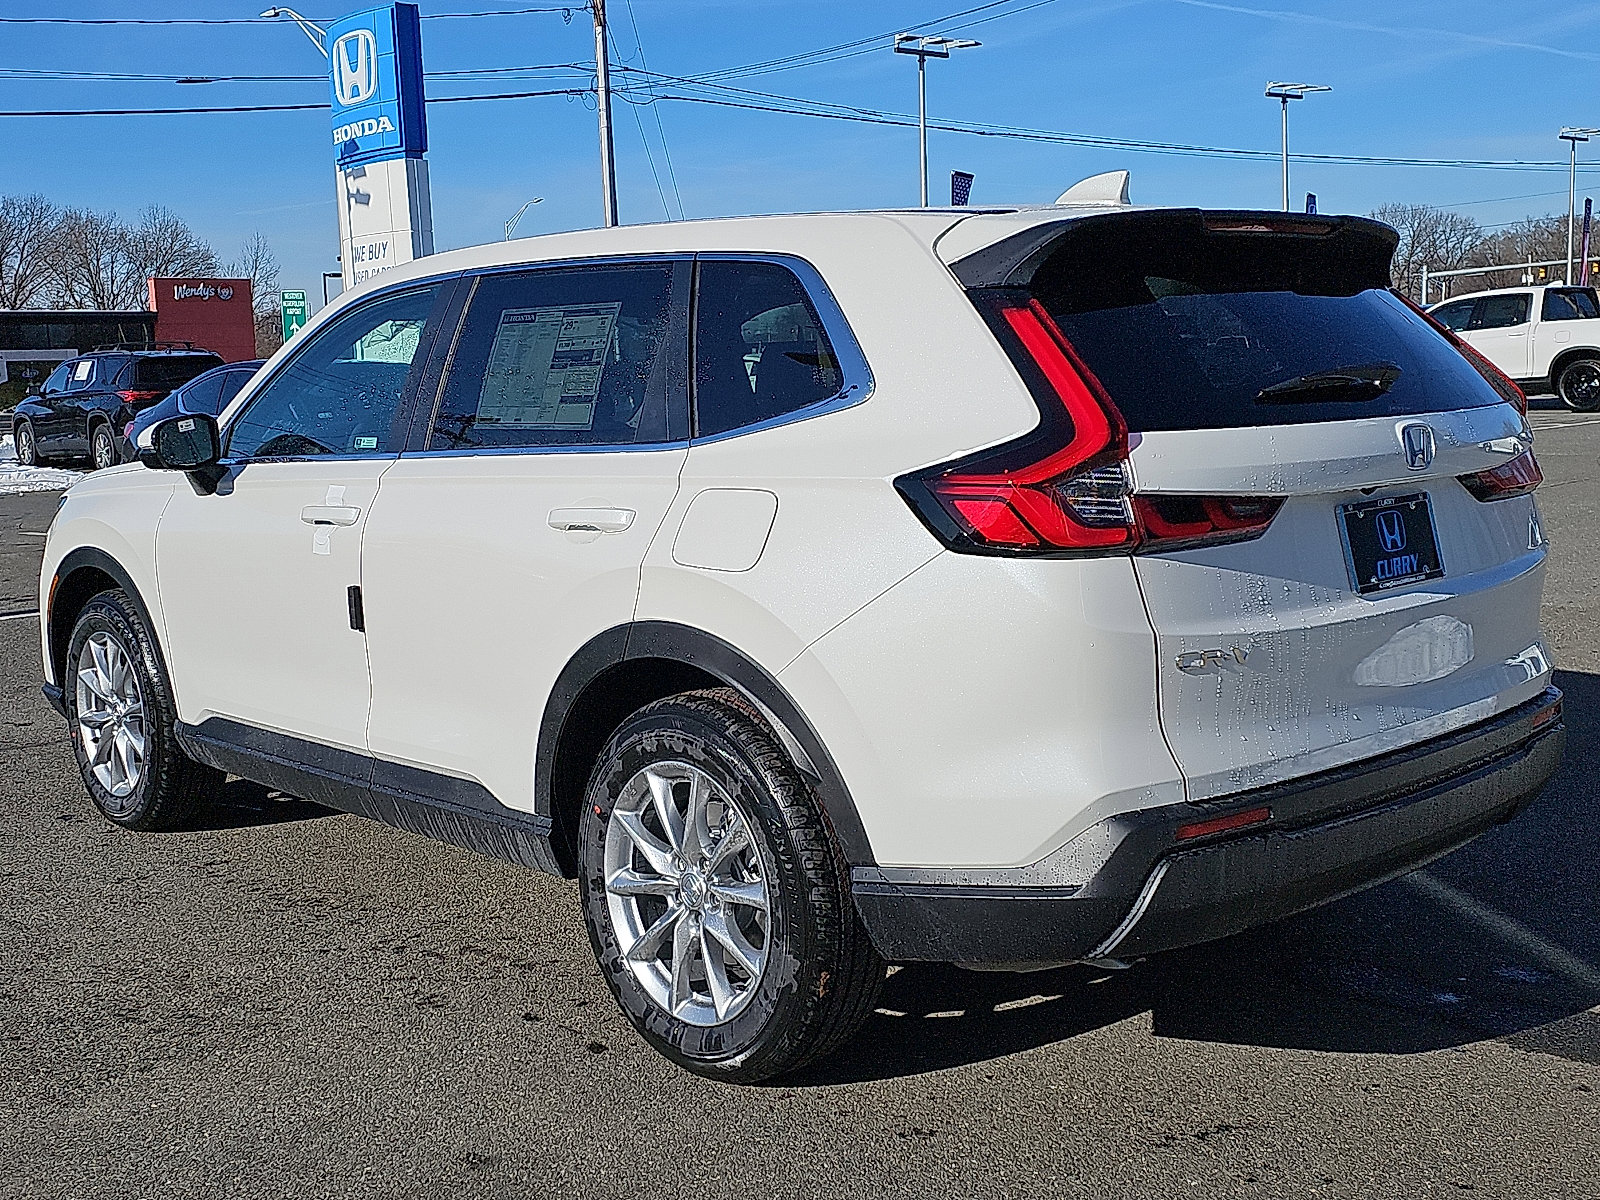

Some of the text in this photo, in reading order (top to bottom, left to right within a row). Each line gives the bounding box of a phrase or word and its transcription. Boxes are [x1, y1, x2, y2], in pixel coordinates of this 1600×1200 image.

[332, 116, 396, 146] HONDA
[354, 241, 388, 263] WE BUY
[173, 282, 215, 300] Wendy's
[1377, 553, 1418, 579] CURRY
